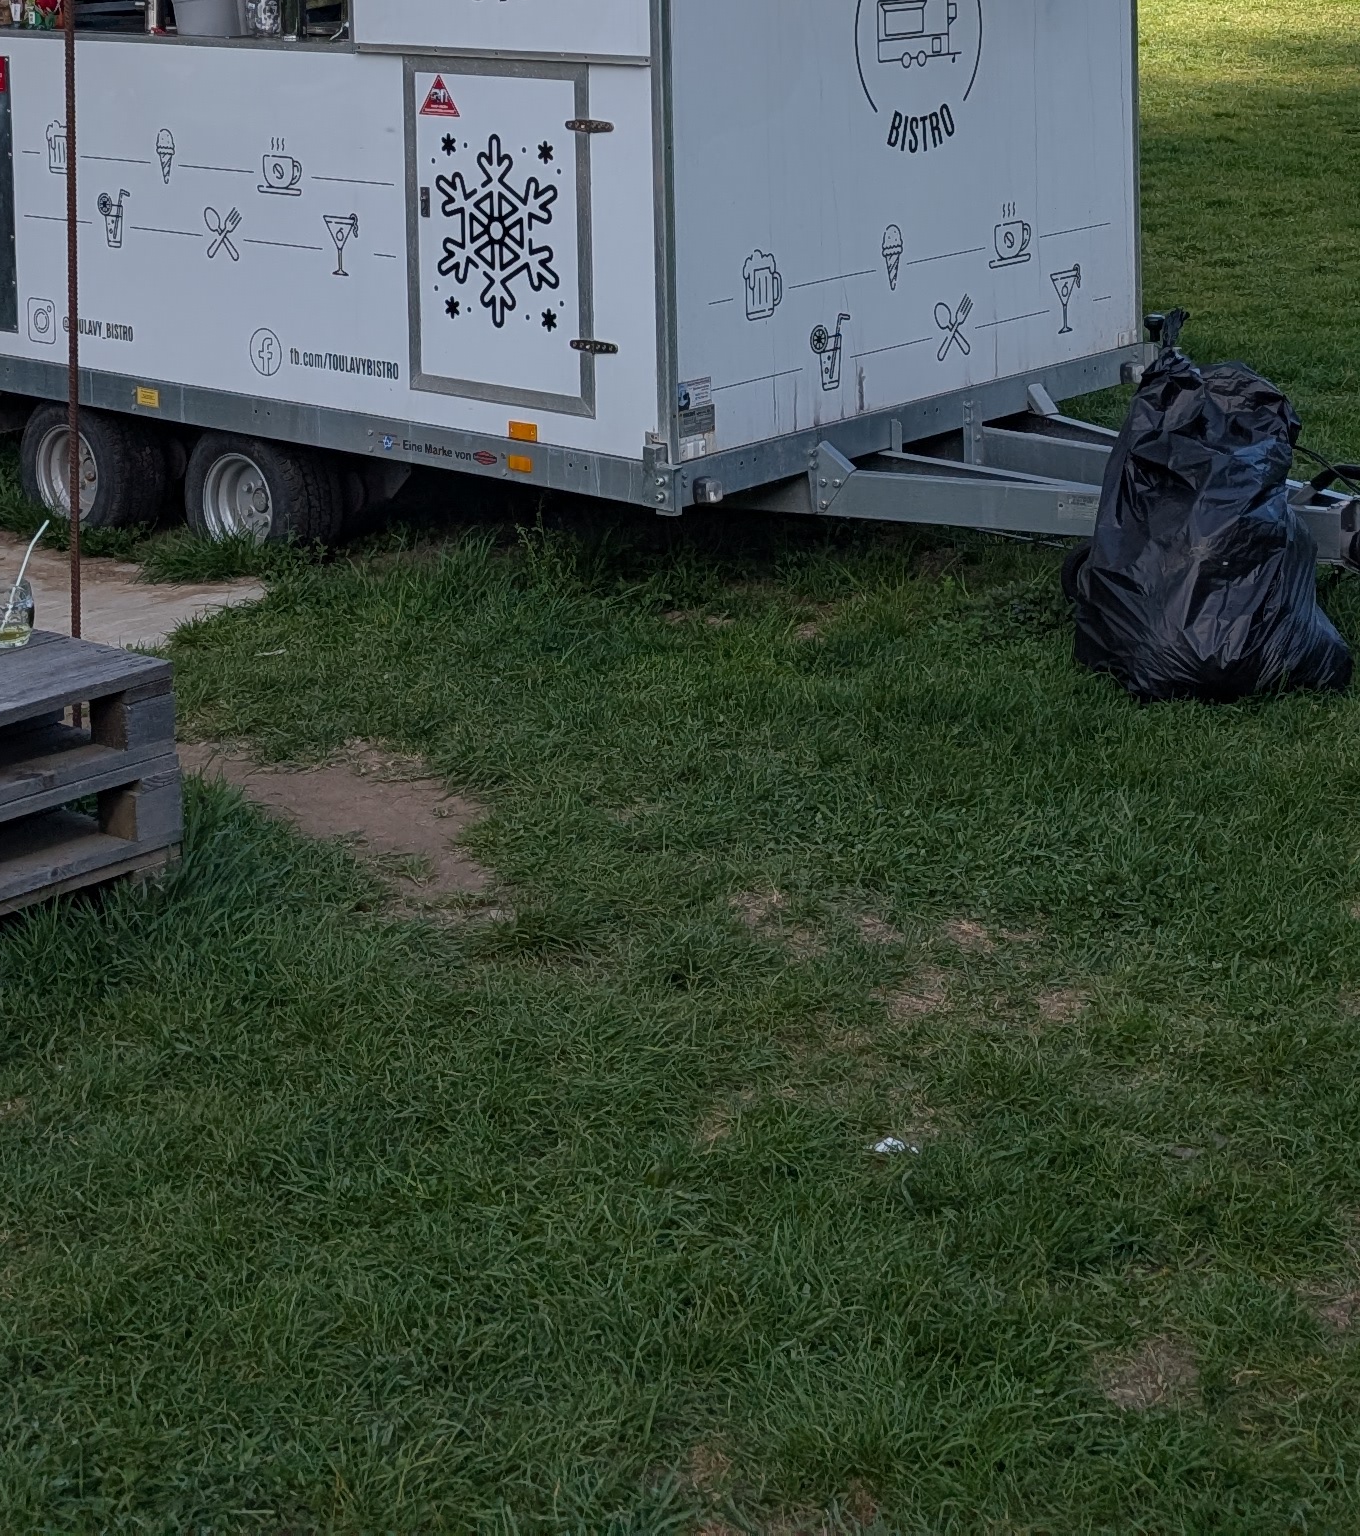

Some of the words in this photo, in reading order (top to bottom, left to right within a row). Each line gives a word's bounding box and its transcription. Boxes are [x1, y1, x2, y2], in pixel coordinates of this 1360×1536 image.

[887, 103, 955, 153] BISTRO
[63, 315, 134, 343] @ULAVY_BISTRO
[289, 347, 400, 381] fb.com/TOULAVYBISTRO
[403, 439, 422, 452] Eine
[425, 443, 452, 457] Marke
[455, 450, 472, 461] von
